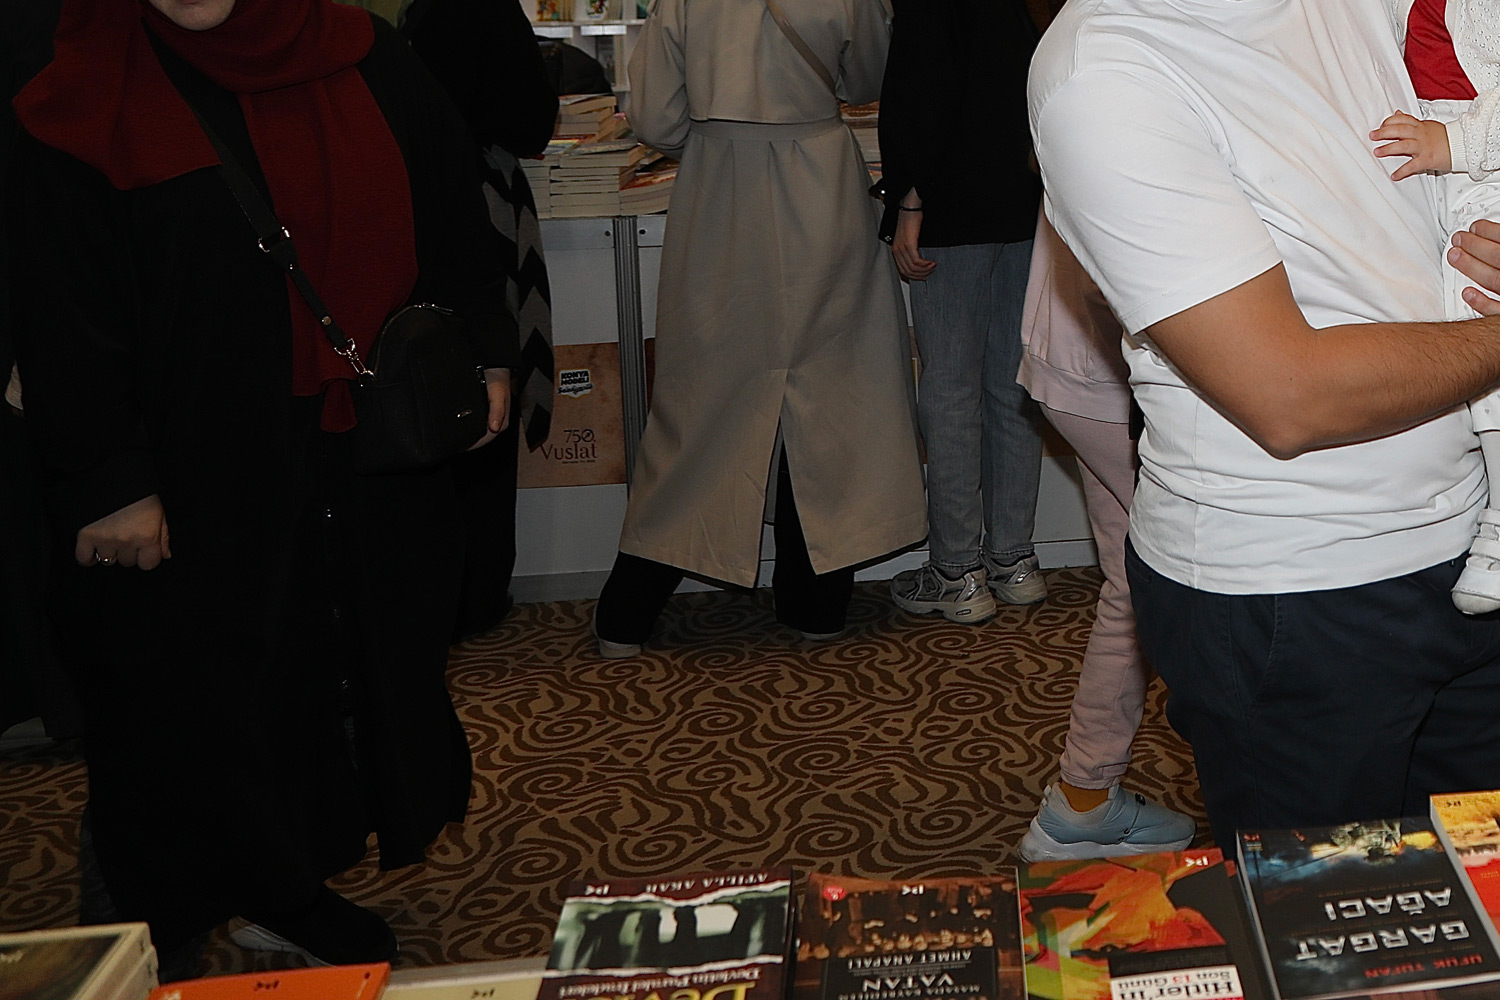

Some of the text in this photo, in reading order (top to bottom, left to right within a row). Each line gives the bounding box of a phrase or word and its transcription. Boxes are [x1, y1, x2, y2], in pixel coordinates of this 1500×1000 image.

[561, 370, 589, 379] KONYA
[540, 443, 598, 461] Vuslat
[1323, 887, 1452, 921] AĞACI
[1294, 920, 1470, 961] GARGAT
[920, 950, 972, 964] AHMET
[1363, 953, 1483, 979] UFUK TUFAN
[862, 973, 954, 992] VATAN
[1118, 978, 1168, 990] Günü
[1196, 972, 1231, 981] Son
[925, 984, 981, 996] MASADA
